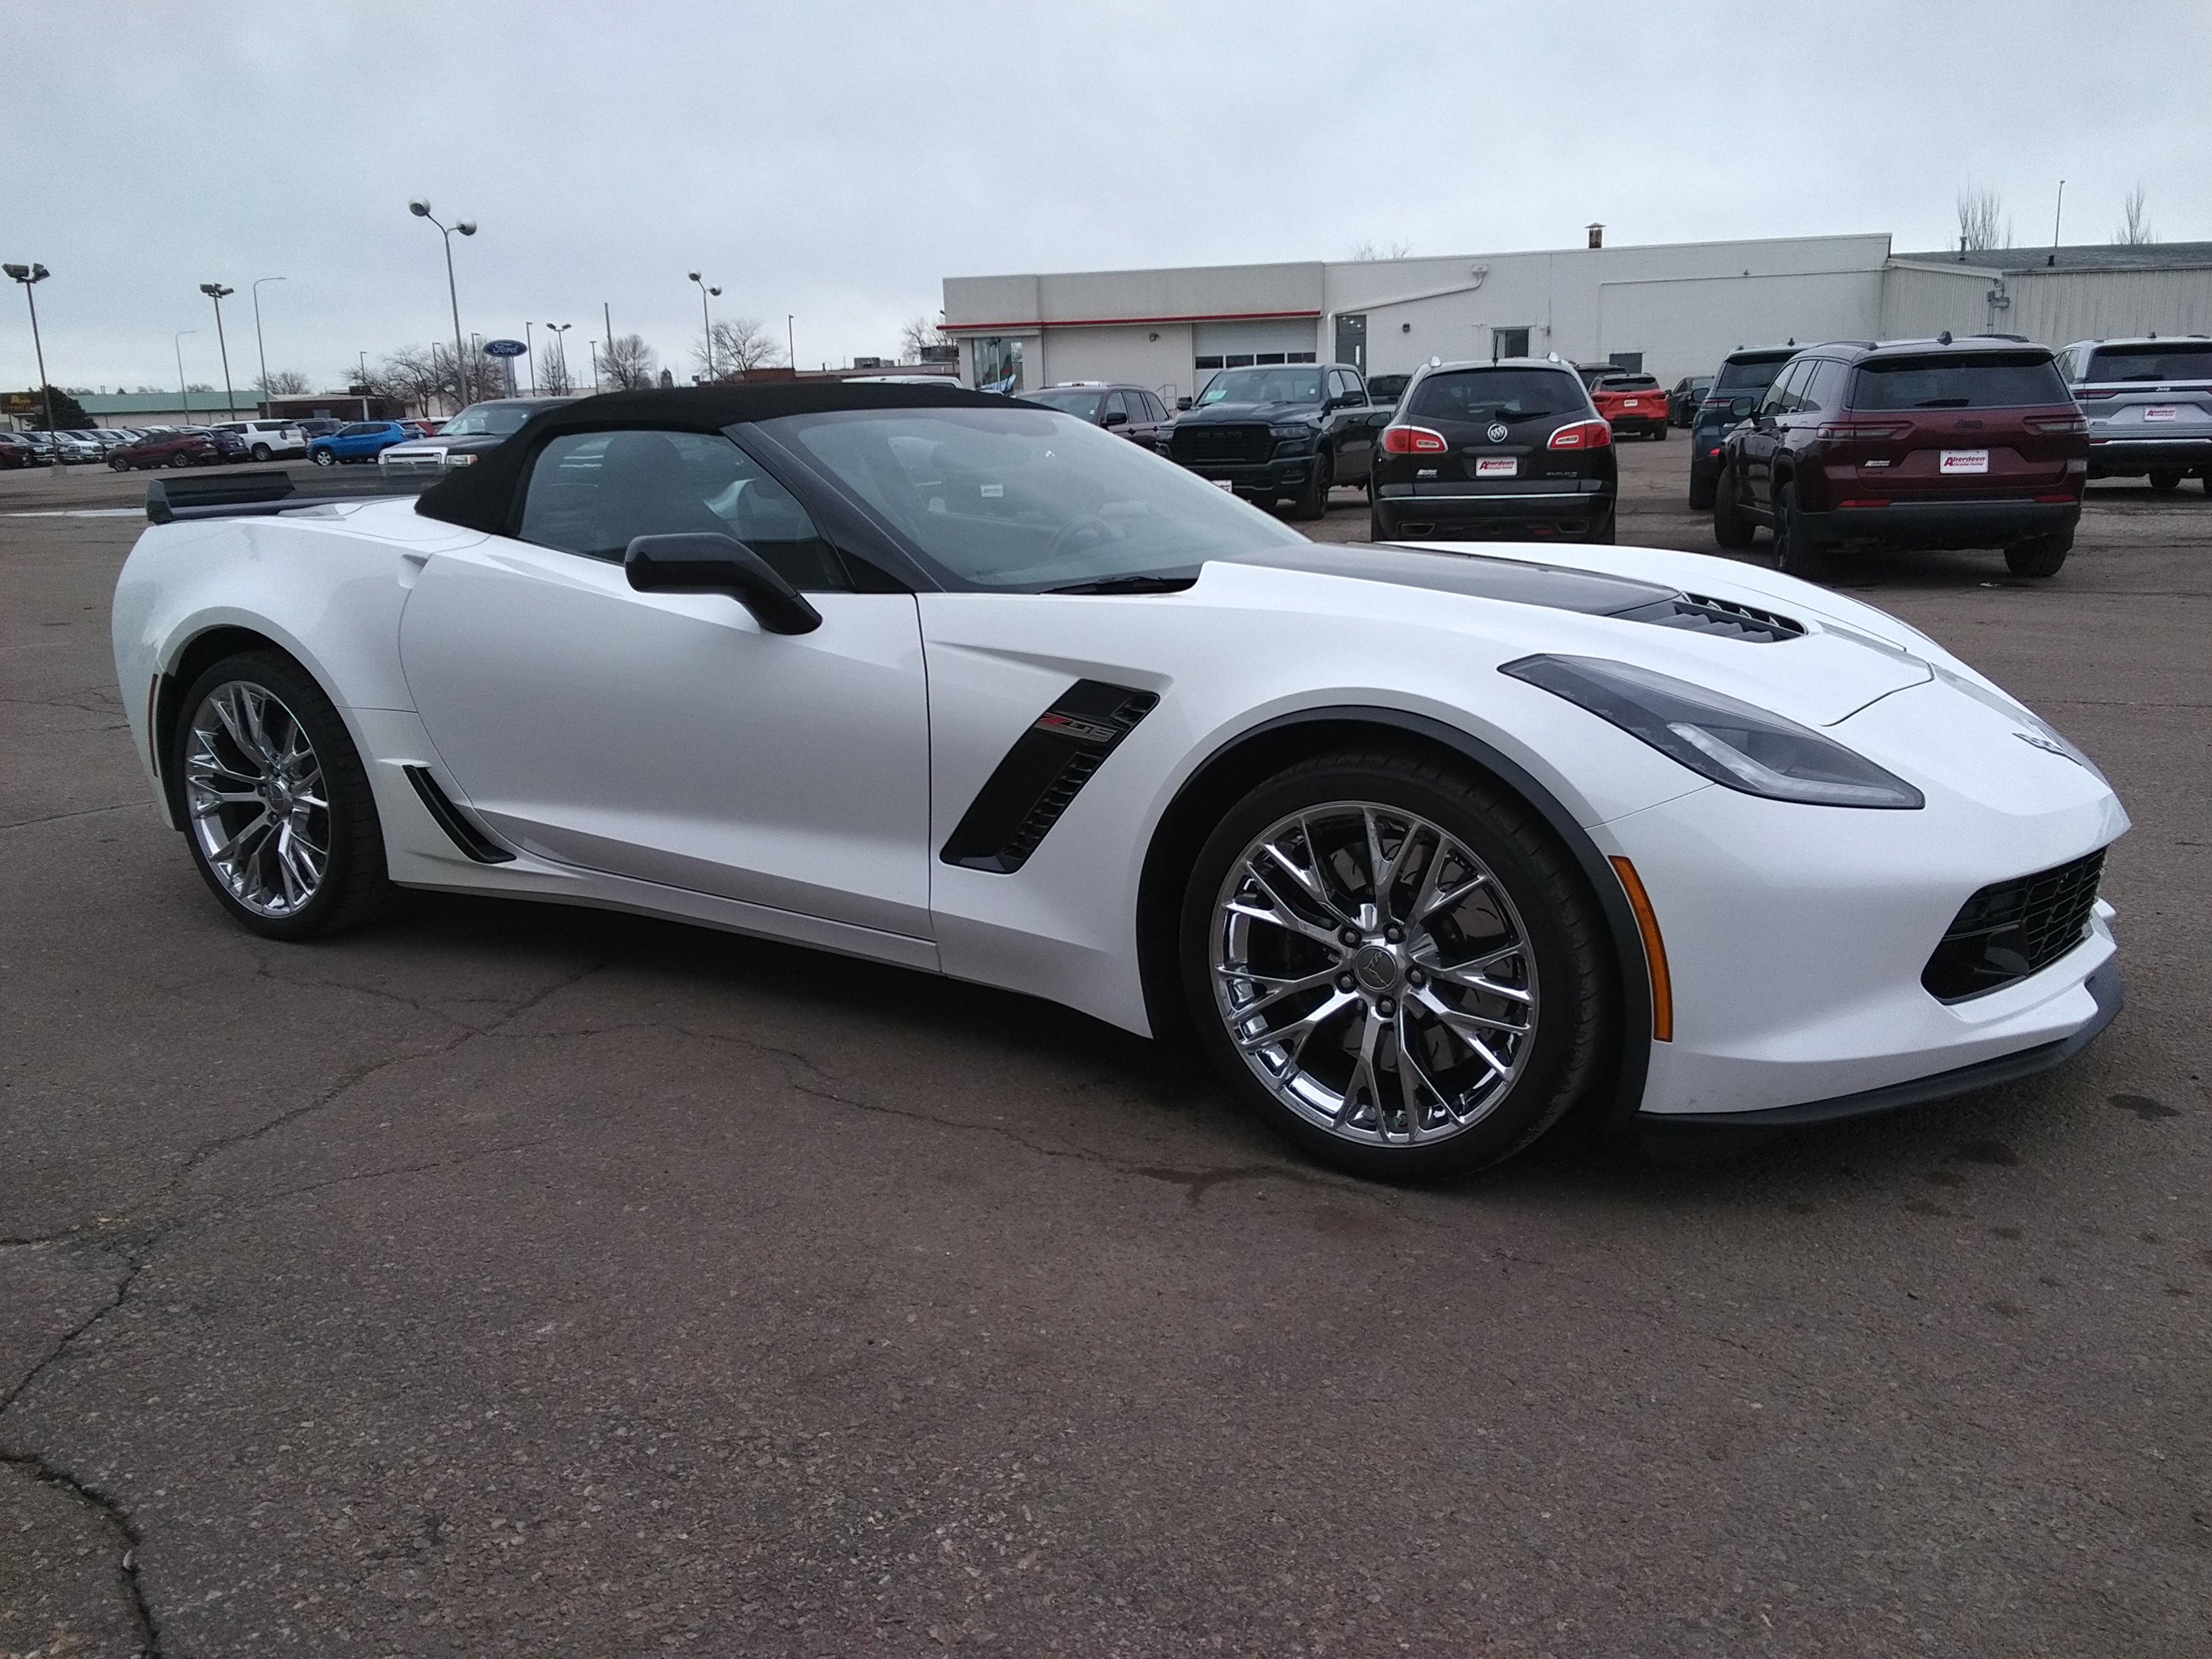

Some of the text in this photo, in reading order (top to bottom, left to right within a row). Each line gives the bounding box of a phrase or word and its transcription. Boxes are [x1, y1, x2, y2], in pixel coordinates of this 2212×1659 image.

[493, 343, 518, 353] Ford
[1479, 461, 1515, 470] Aberdeen
[1944, 456, 1986, 466] Aberdeen
